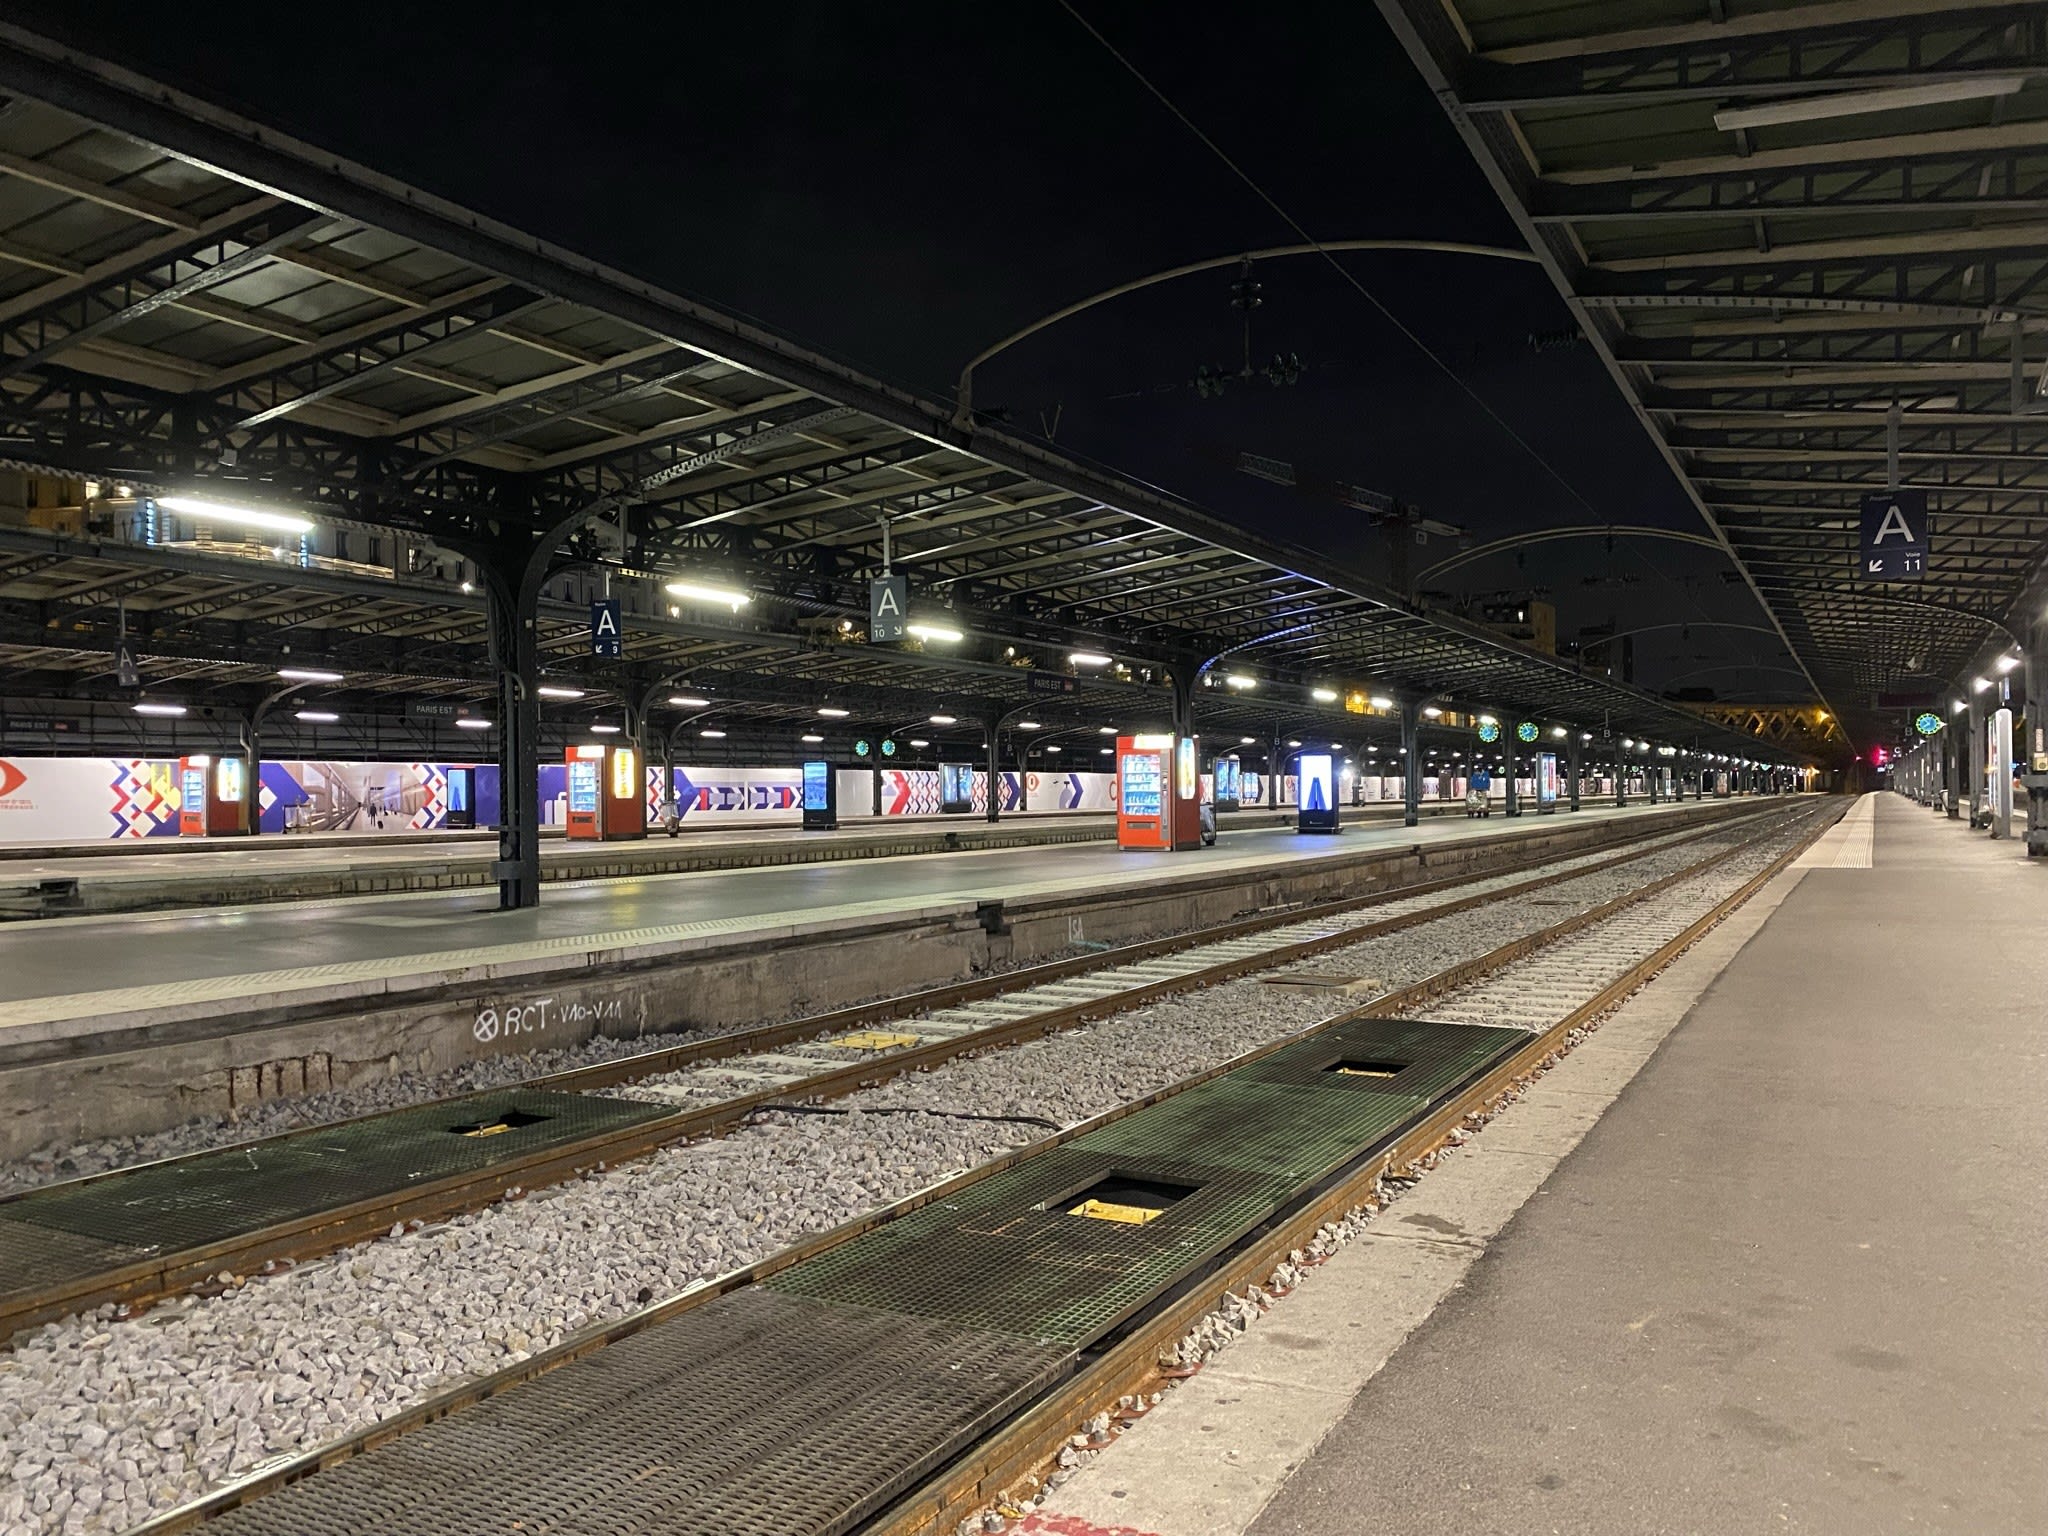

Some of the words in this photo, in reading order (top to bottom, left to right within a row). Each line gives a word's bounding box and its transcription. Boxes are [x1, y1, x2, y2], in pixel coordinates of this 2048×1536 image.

[1873, 505, 1915, 545] A
[1904, 559, 1921, 572] 11
[877, 587, 900, 617] A
[597, 609, 616, 636] A
[874, 629, 885, 638] 10
[612, 645, 618, 654] 9
[120, 647, 133, 668] A
[1034, 679, 1050, 689] PARIS
[1050, 680, 1061, 689] EST
[416, 705, 438, 714] PARIS
[439, 706, 453, 714] EST
[1604, 729, 1610, 738] B
[1905, 727, 1913, 736] B
[1894, 746, 1901, 754] C
[504, 998, 553, 1036] RCT
